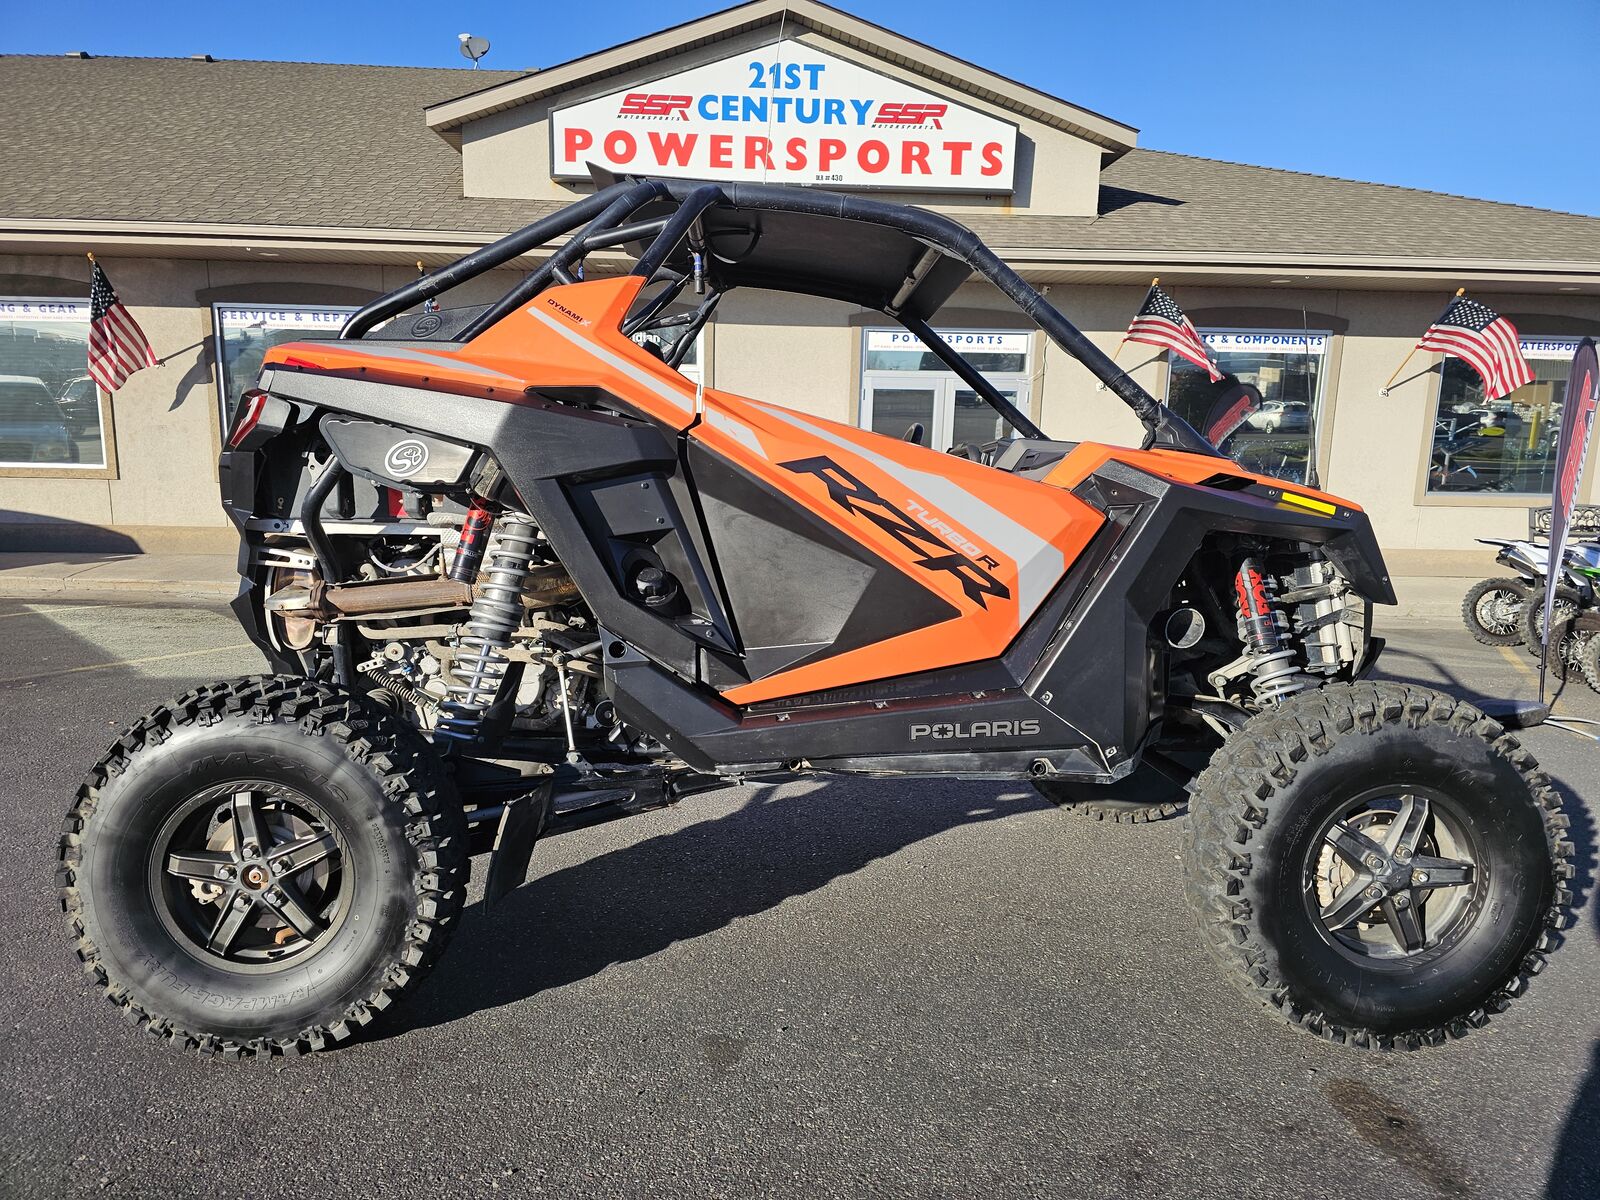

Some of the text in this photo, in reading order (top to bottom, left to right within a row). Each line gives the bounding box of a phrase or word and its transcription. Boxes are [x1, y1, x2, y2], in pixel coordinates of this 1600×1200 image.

[748, 62, 825, 91] 21ST
[619, 93, 693, 121] SSR
[698, 95, 874, 126] CENTURY
[874, 103, 948, 130] SSR
[564, 128, 1002, 176] POWERSPORTS
[831, 174, 843, 182] 430
[23, 304, 31, 313] &
[39, 304, 77, 313] GEAR
[221, 310, 352, 323] SERVICE & REPA
[892, 334, 1003, 345] POWSPORTS
[1221, 335, 1229, 344] &
[1235, 335, 1322, 346] COMPONENTS
[776, 455, 1011, 611] RZR
[907, 499, 983, 557] TURBO
[910, 720, 1041, 741] POLARIS
